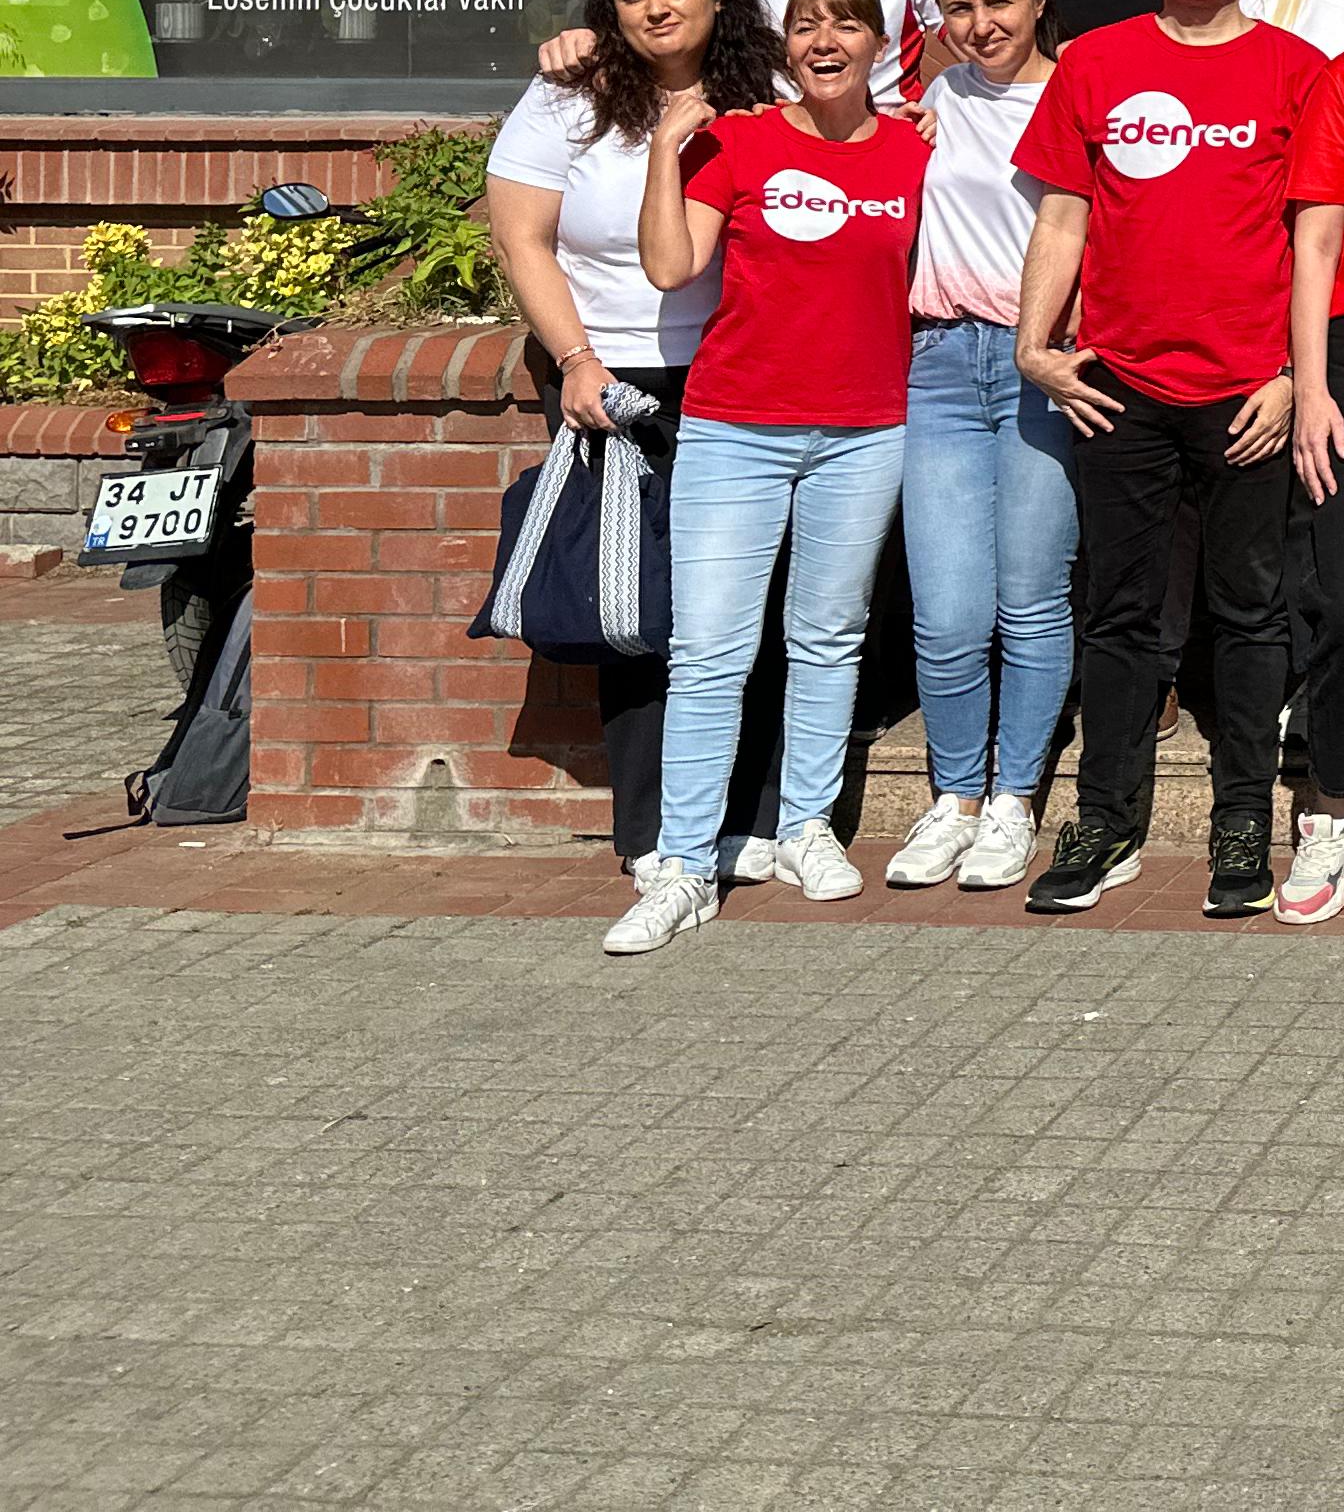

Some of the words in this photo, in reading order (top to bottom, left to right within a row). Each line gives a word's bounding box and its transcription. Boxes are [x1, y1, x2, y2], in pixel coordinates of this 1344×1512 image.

[1103, 117, 1257, 149] Edenred
[762, 187, 906, 220] Edenred
[105, 480, 146, 507] 34
[170, 474, 212, 501] JT
[118, 508, 202, 540] 9700
[91, 536, 106, 546] TR
